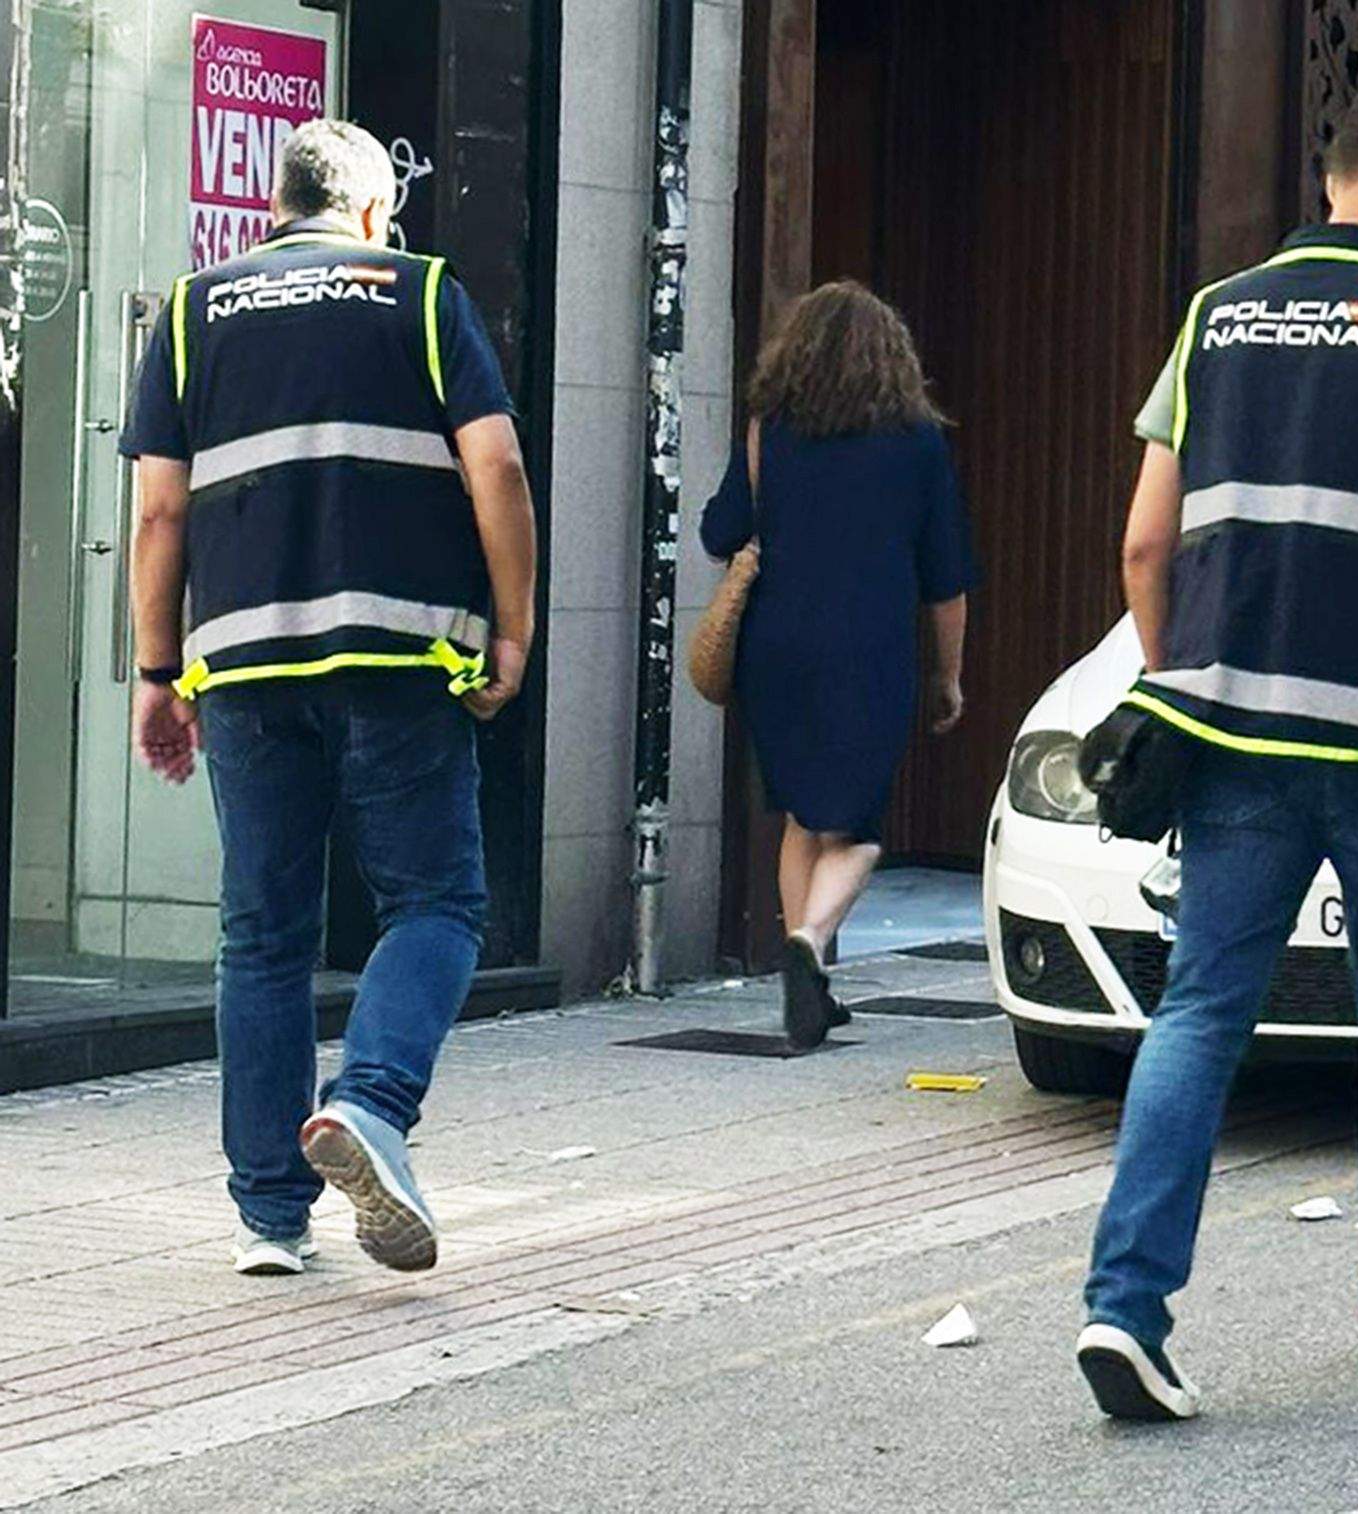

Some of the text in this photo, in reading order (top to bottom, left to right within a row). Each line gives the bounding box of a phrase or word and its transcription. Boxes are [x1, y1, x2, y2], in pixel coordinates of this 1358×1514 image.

[197, 105, 296, 201] VEND
[206, 281, 397, 324] NACIONAL
[207, 264, 350, 302] POLICIA
[1207, 300, 1350, 326] POLICIA
